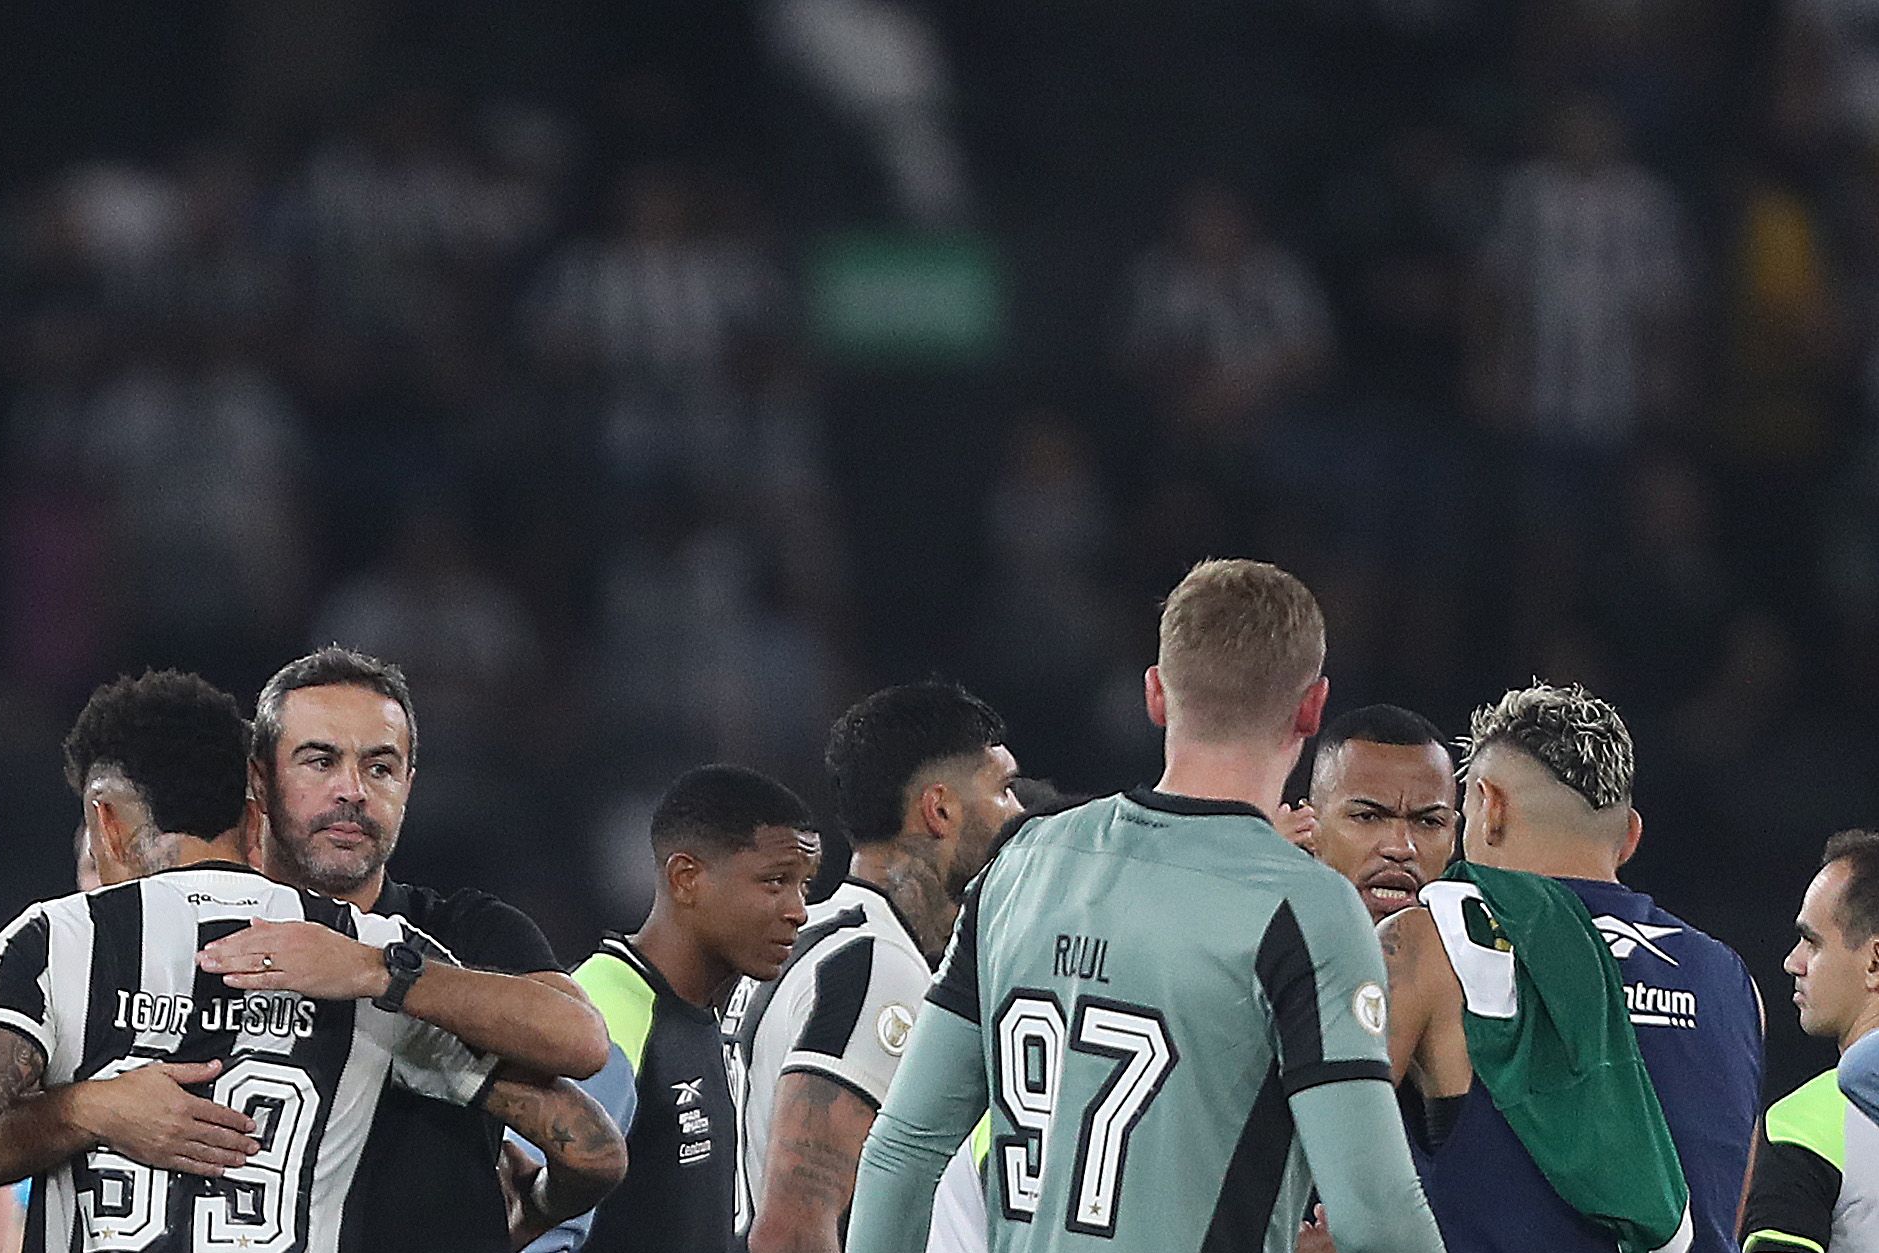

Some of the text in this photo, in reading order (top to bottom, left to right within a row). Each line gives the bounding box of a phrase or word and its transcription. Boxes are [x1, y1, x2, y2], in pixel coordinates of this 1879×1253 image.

[114, 990, 317, 1037] IGOR JESUS
[993, 988, 1180, 1240] 97
